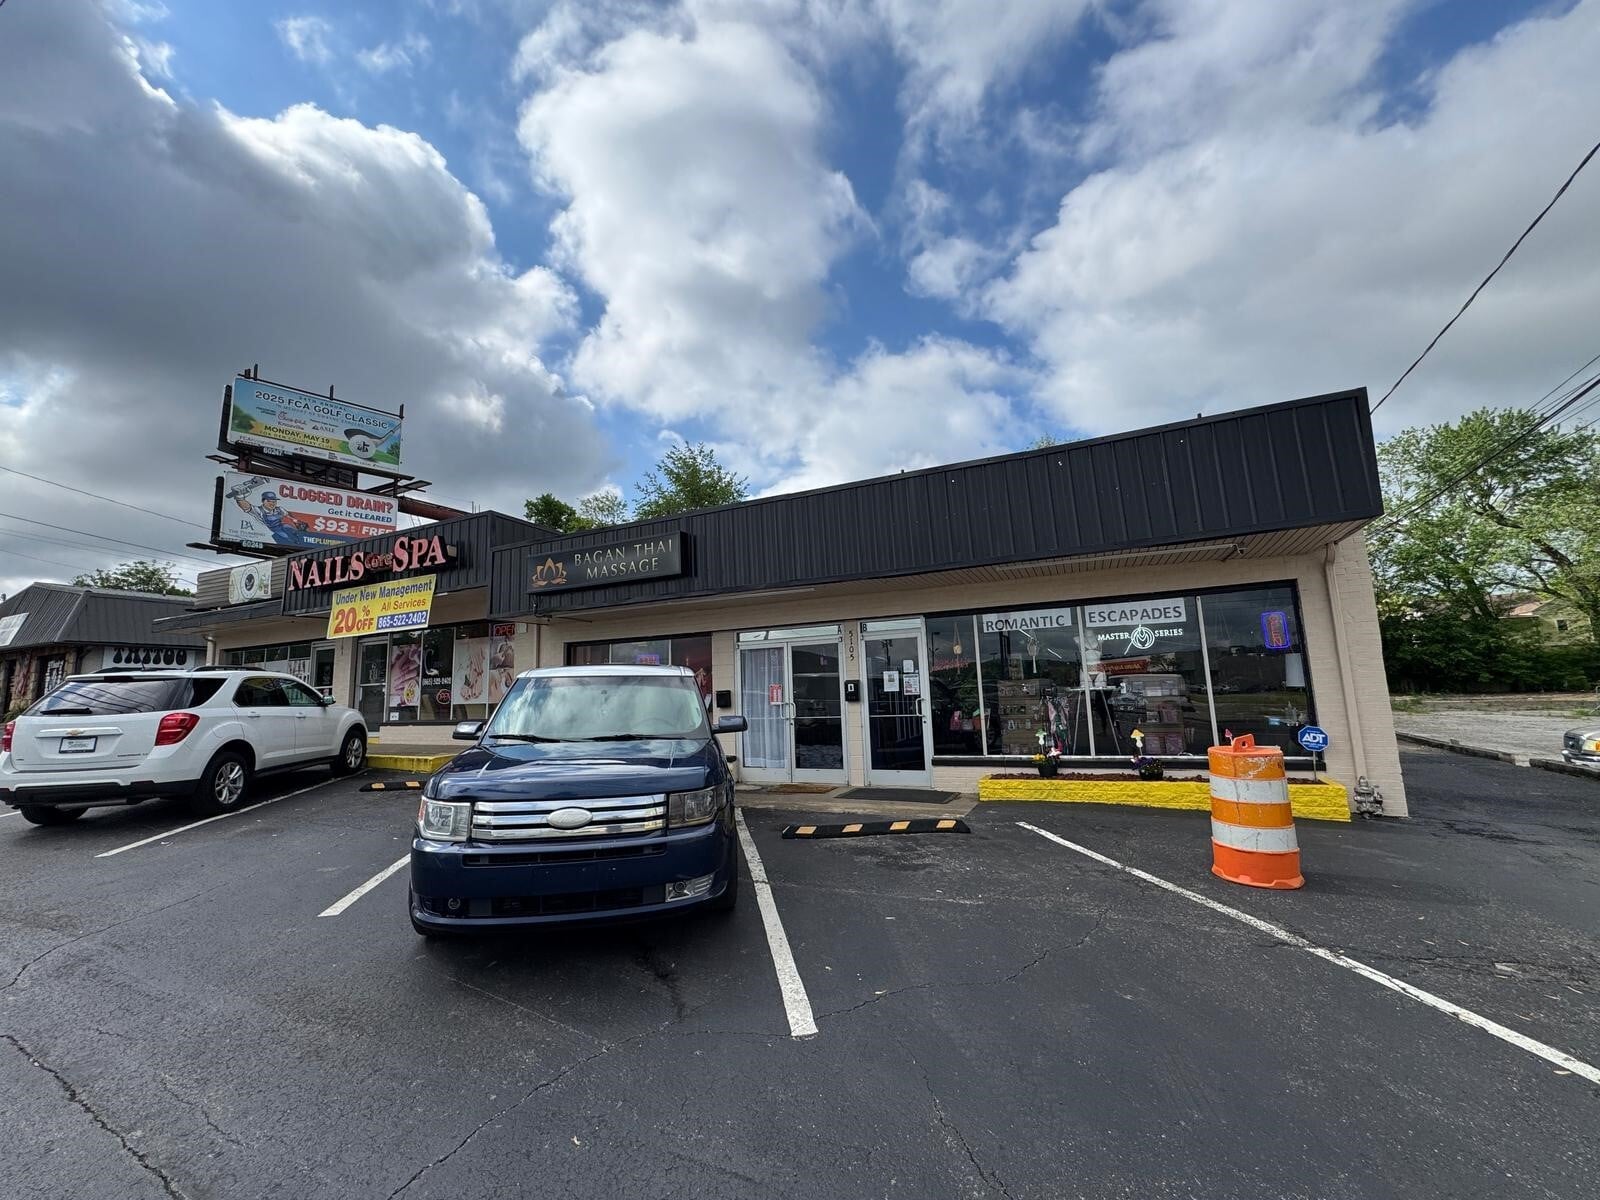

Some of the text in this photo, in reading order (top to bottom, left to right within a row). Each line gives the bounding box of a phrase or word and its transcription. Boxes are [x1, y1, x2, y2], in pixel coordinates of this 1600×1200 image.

[255, 390, 284, 404] 2025
[288, 399, 310, 410] FCA
[313, 405, 343, 417] GOLF
[345, 413, 388, 429] CLASSIC
[264, 425, 302, 439] MONDAY,
[303, 433, 320, 442] MAY
[278, 484, 343, 507] CLOGGED
[314, 516, 349, 534] $93
[328, 508, 392, 524] Get it CLEARED
[574, 538, 673, 567] BAGAN THAI
[288, 551, 365, 591] NAILS
[392, 535, 447, 572] SPA
[586, 557, 660, 580] MASSAGE
[335, 581, 433, 606] Under New Management
[381, 597, 427, 612] All Services
[333, 604, 371, 634] 20 %
[356, 617, 375, 632] OFF
[377, 611, 427, 629] 865-522-2402
[985, 605, 1183, 632] ROMANTIC ESCAPADES
[495, 624, 514, 636] OPE
[862, 624, 868, 632] B
[1097, 628, 1183, 642] MASTER SERIES
[848, 630, 856, 661] 5105
[1301, 732, 1326, 744] ADT
